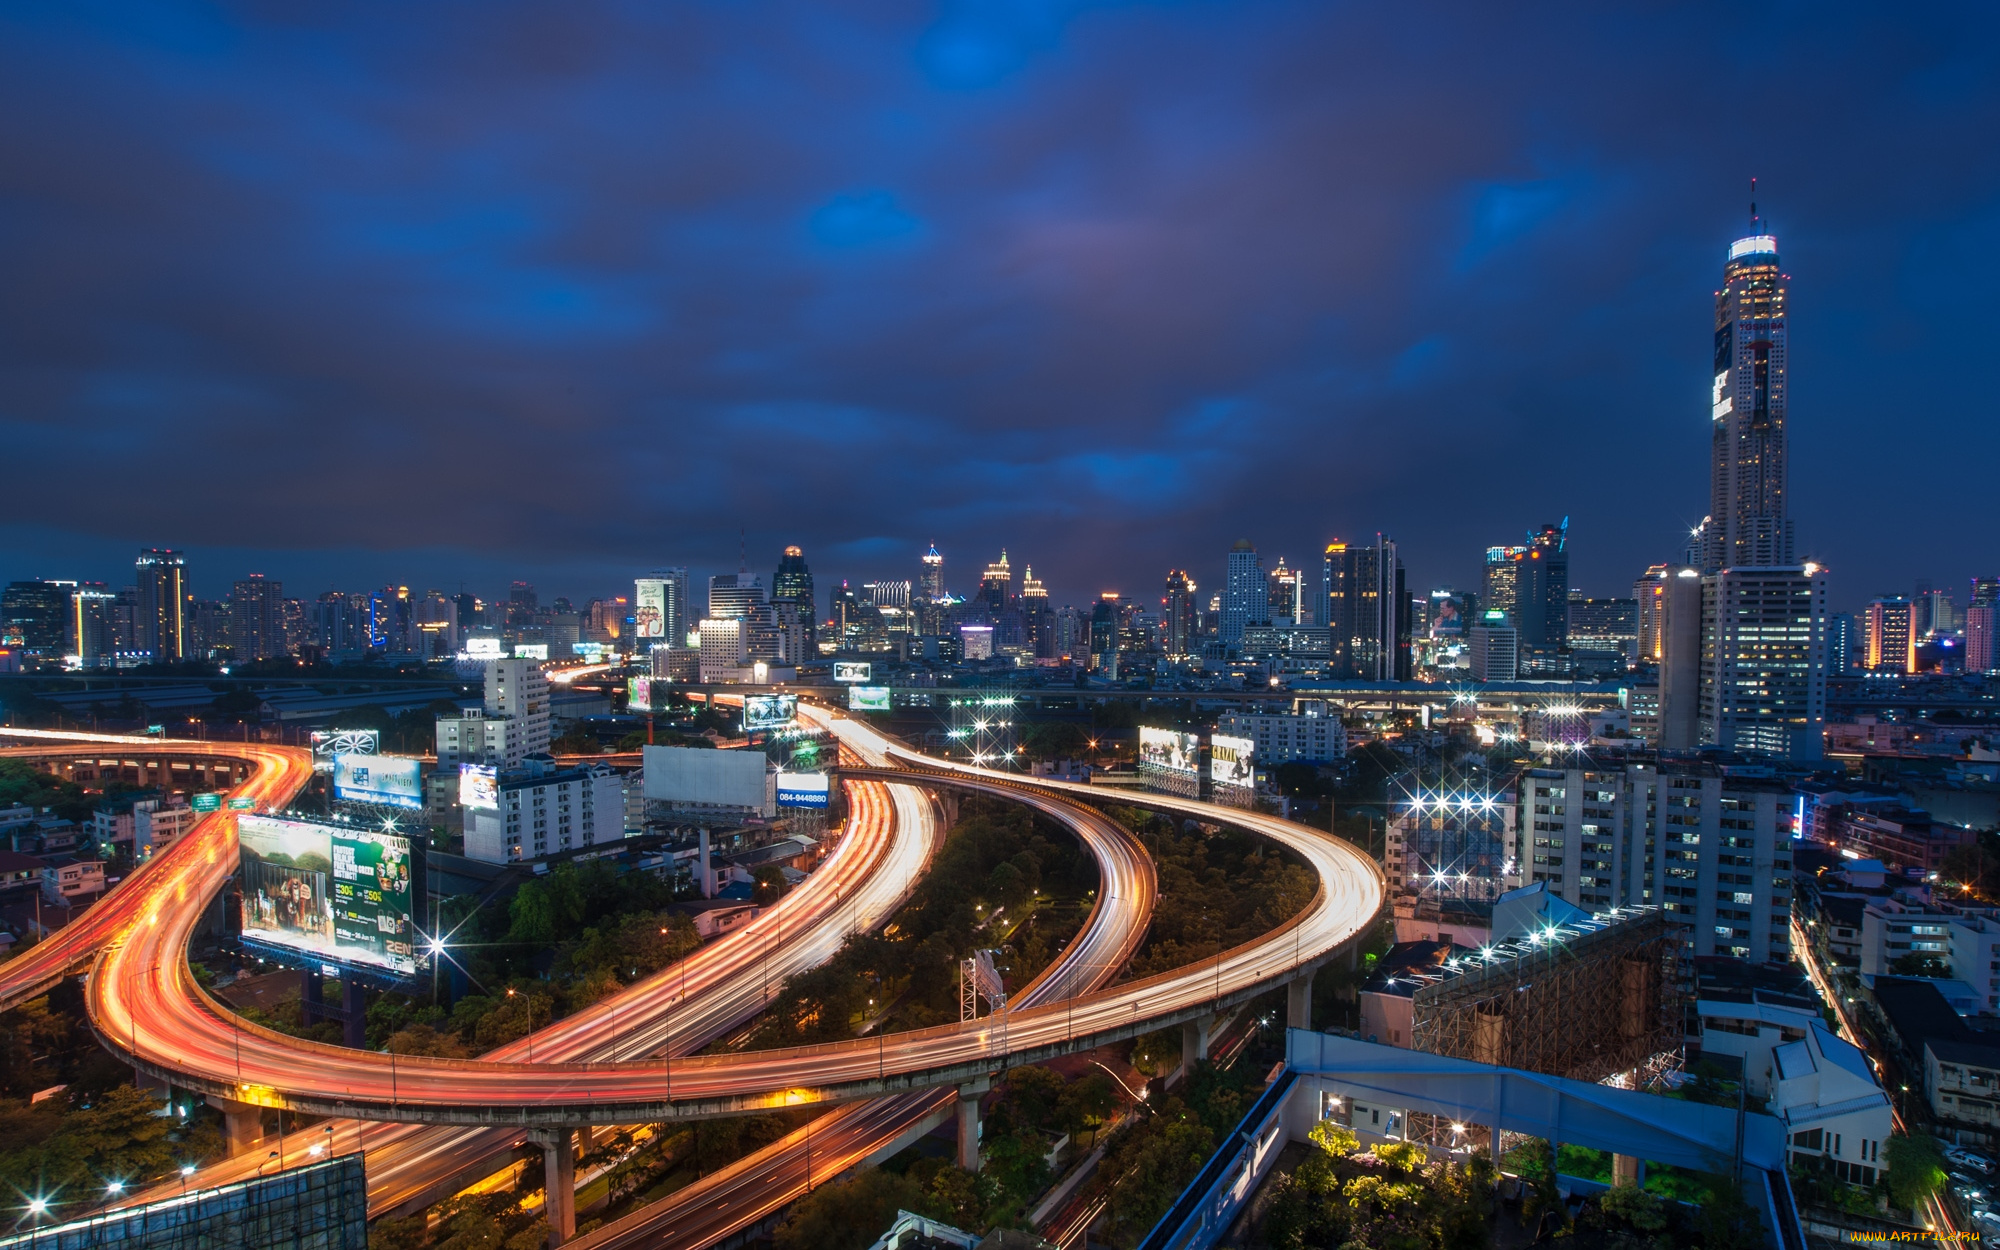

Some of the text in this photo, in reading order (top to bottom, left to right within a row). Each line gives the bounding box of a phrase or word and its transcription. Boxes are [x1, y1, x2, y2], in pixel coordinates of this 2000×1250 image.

[1739, 322, 1784, 331] TOSHIBA
[1212, 745, 1237, 762] GRAZIA
[779, 793, 827, 803] 084-9448880
[386, 939, 412, 955] ZEN
